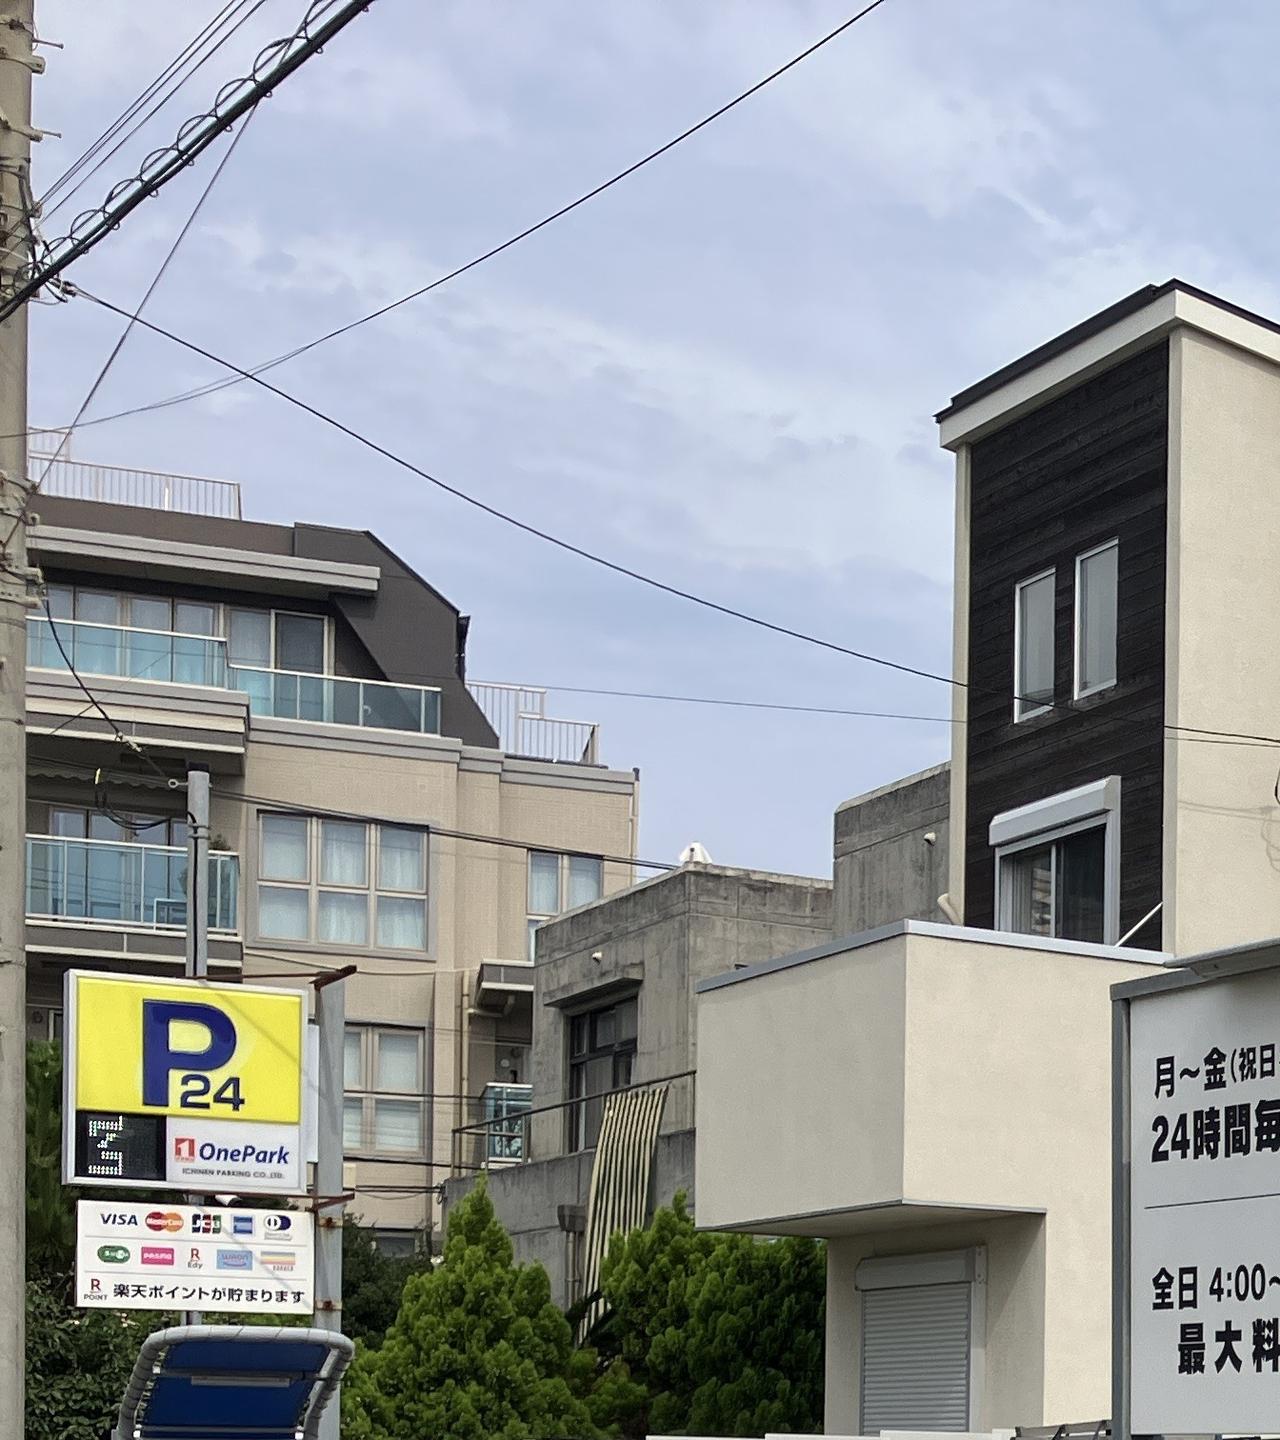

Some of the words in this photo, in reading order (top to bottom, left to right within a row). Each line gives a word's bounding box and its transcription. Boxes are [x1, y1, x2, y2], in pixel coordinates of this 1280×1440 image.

[142, 998, 238, 1108] P
[180, 1074, 246, 1112] 24
[199, 1142, 290, 1165] OnePark
[216, 1169, 251, 1178] PARKING
[100, 1213, 139, 1226] VISA
[192, 1213, 222, 1234] JCB
[187, 1261, 203, 1270] Edy
[83, 1293, 108, 1301] POINT
[113, 1283, 305, 1304] 楽天ポイントが貯まります
[1151, 1264, 1200, 1312] 全日
